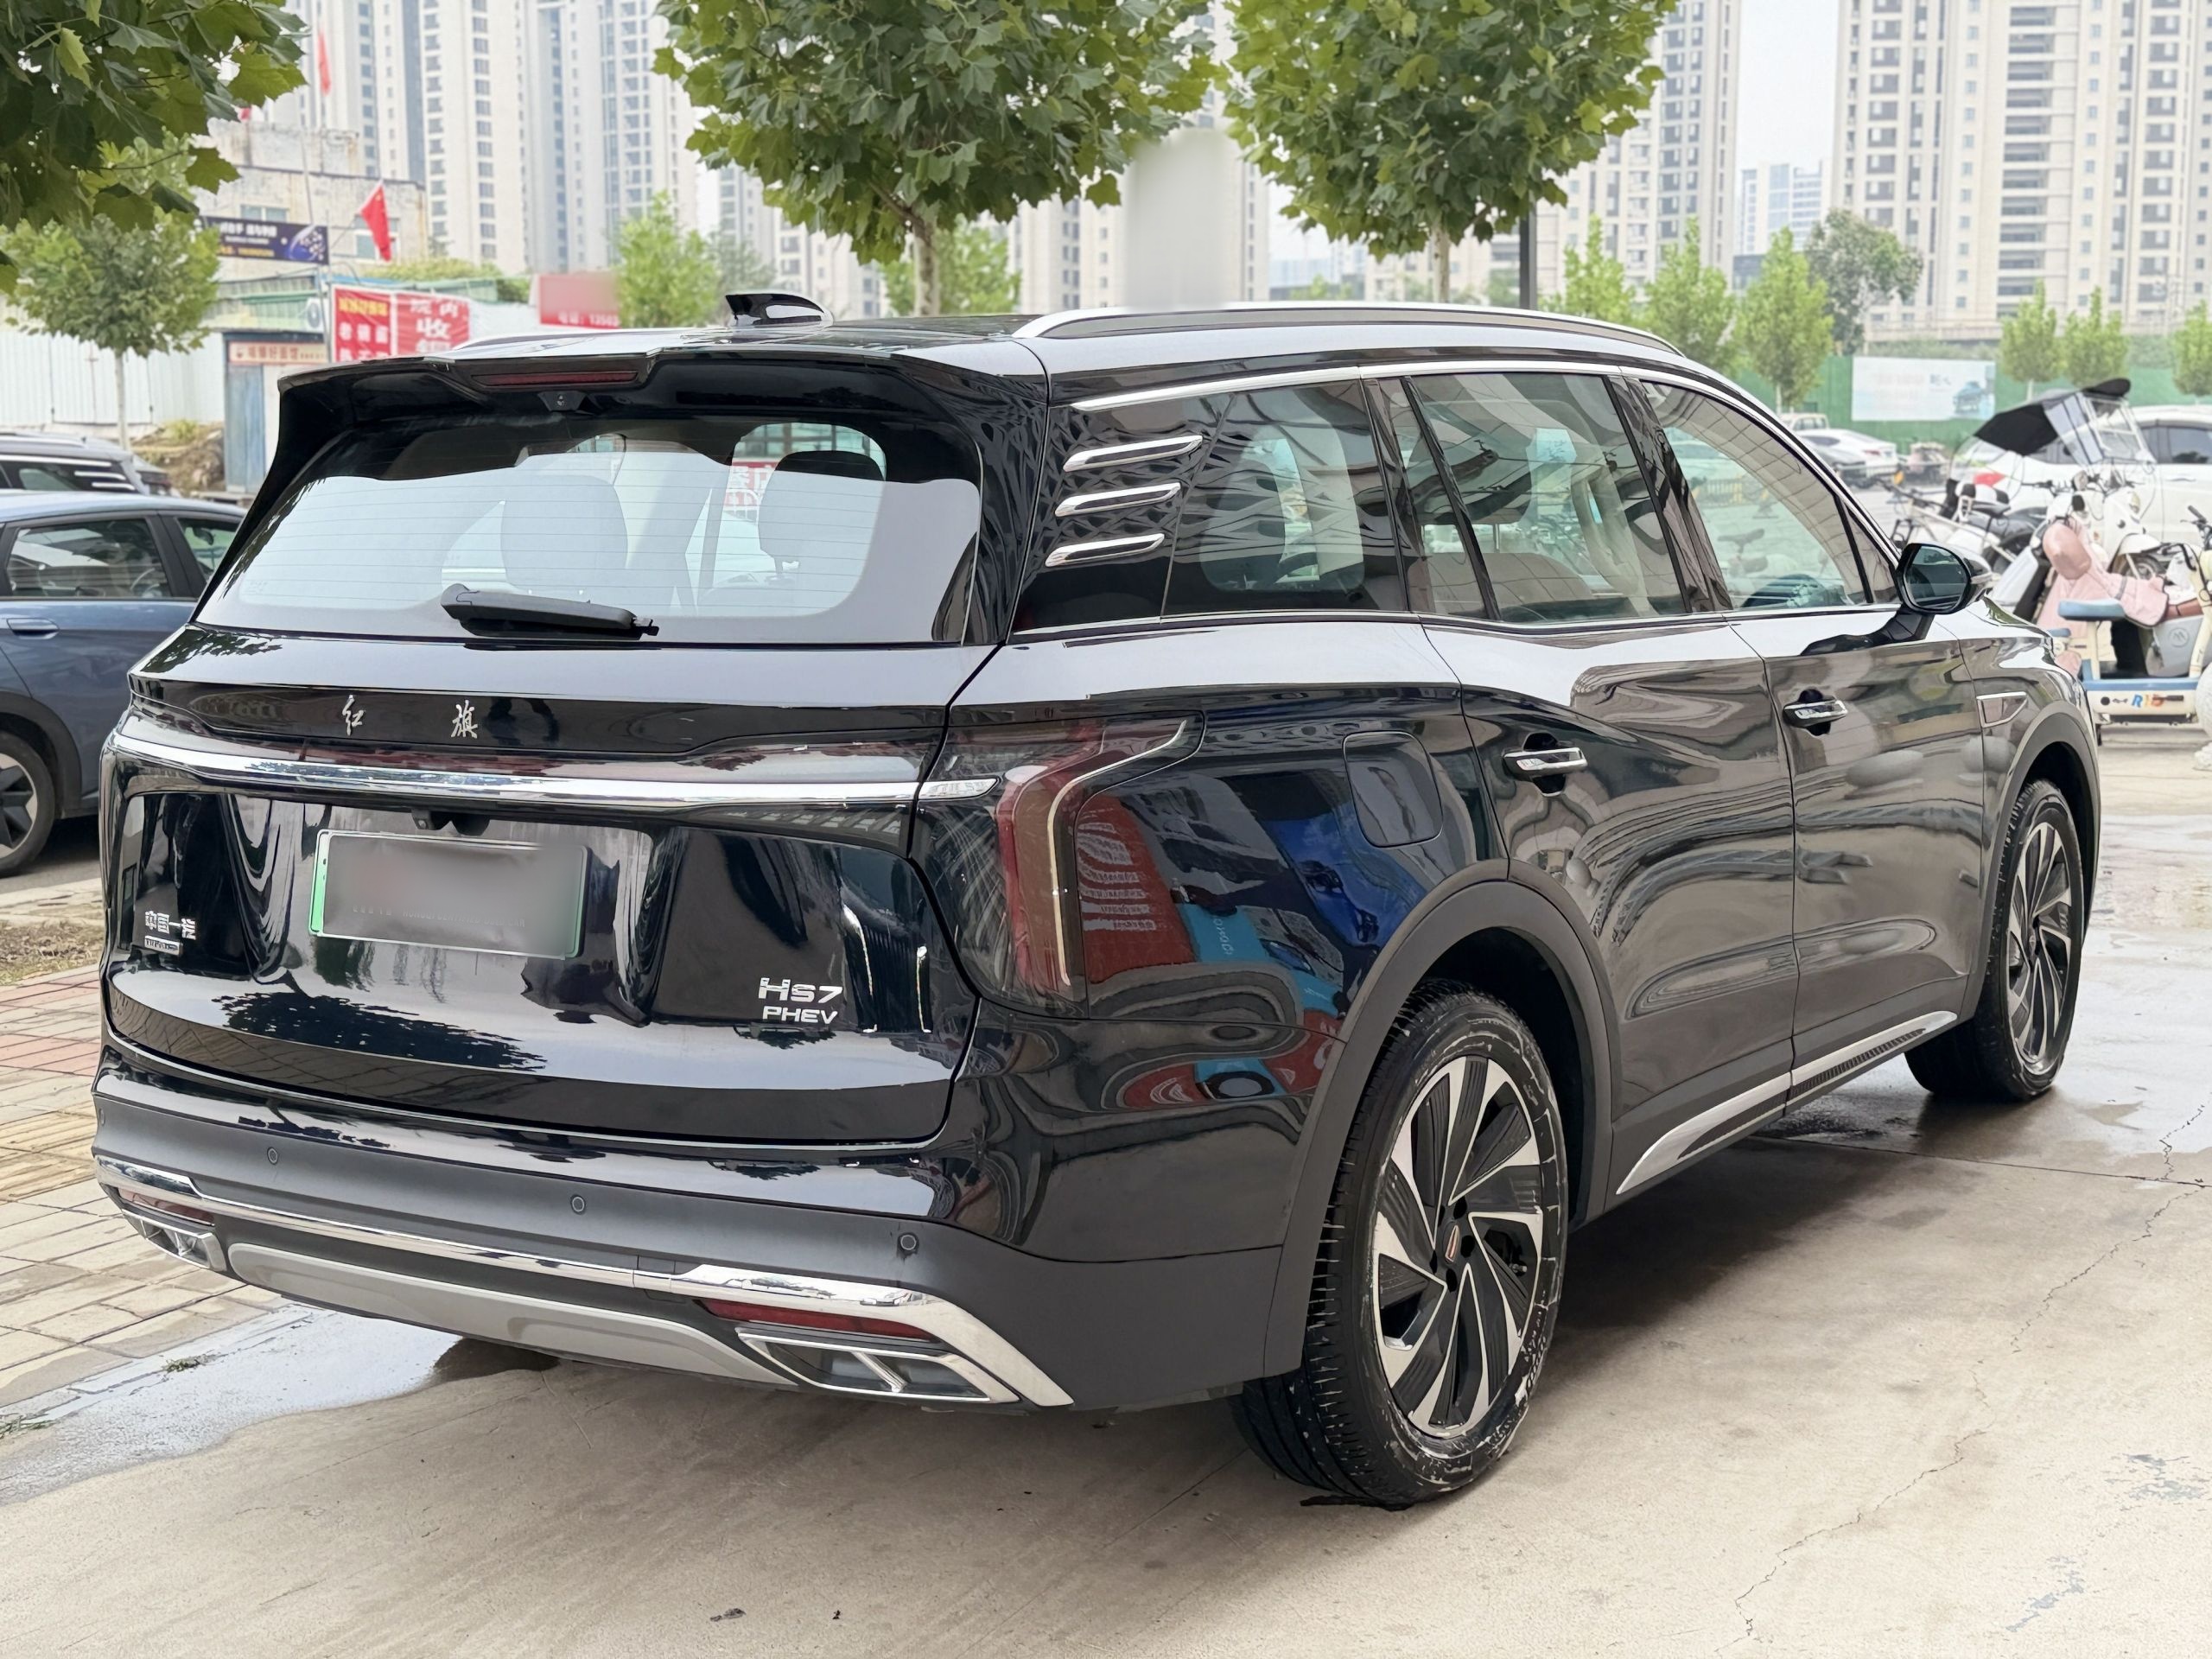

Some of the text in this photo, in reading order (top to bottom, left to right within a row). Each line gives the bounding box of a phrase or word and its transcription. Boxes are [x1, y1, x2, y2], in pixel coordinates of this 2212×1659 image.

[342, 694, 479, 739] 红旗
[758, 977, 843, 1004] HS7
[762, 1005, 839, 1025] PHEV
